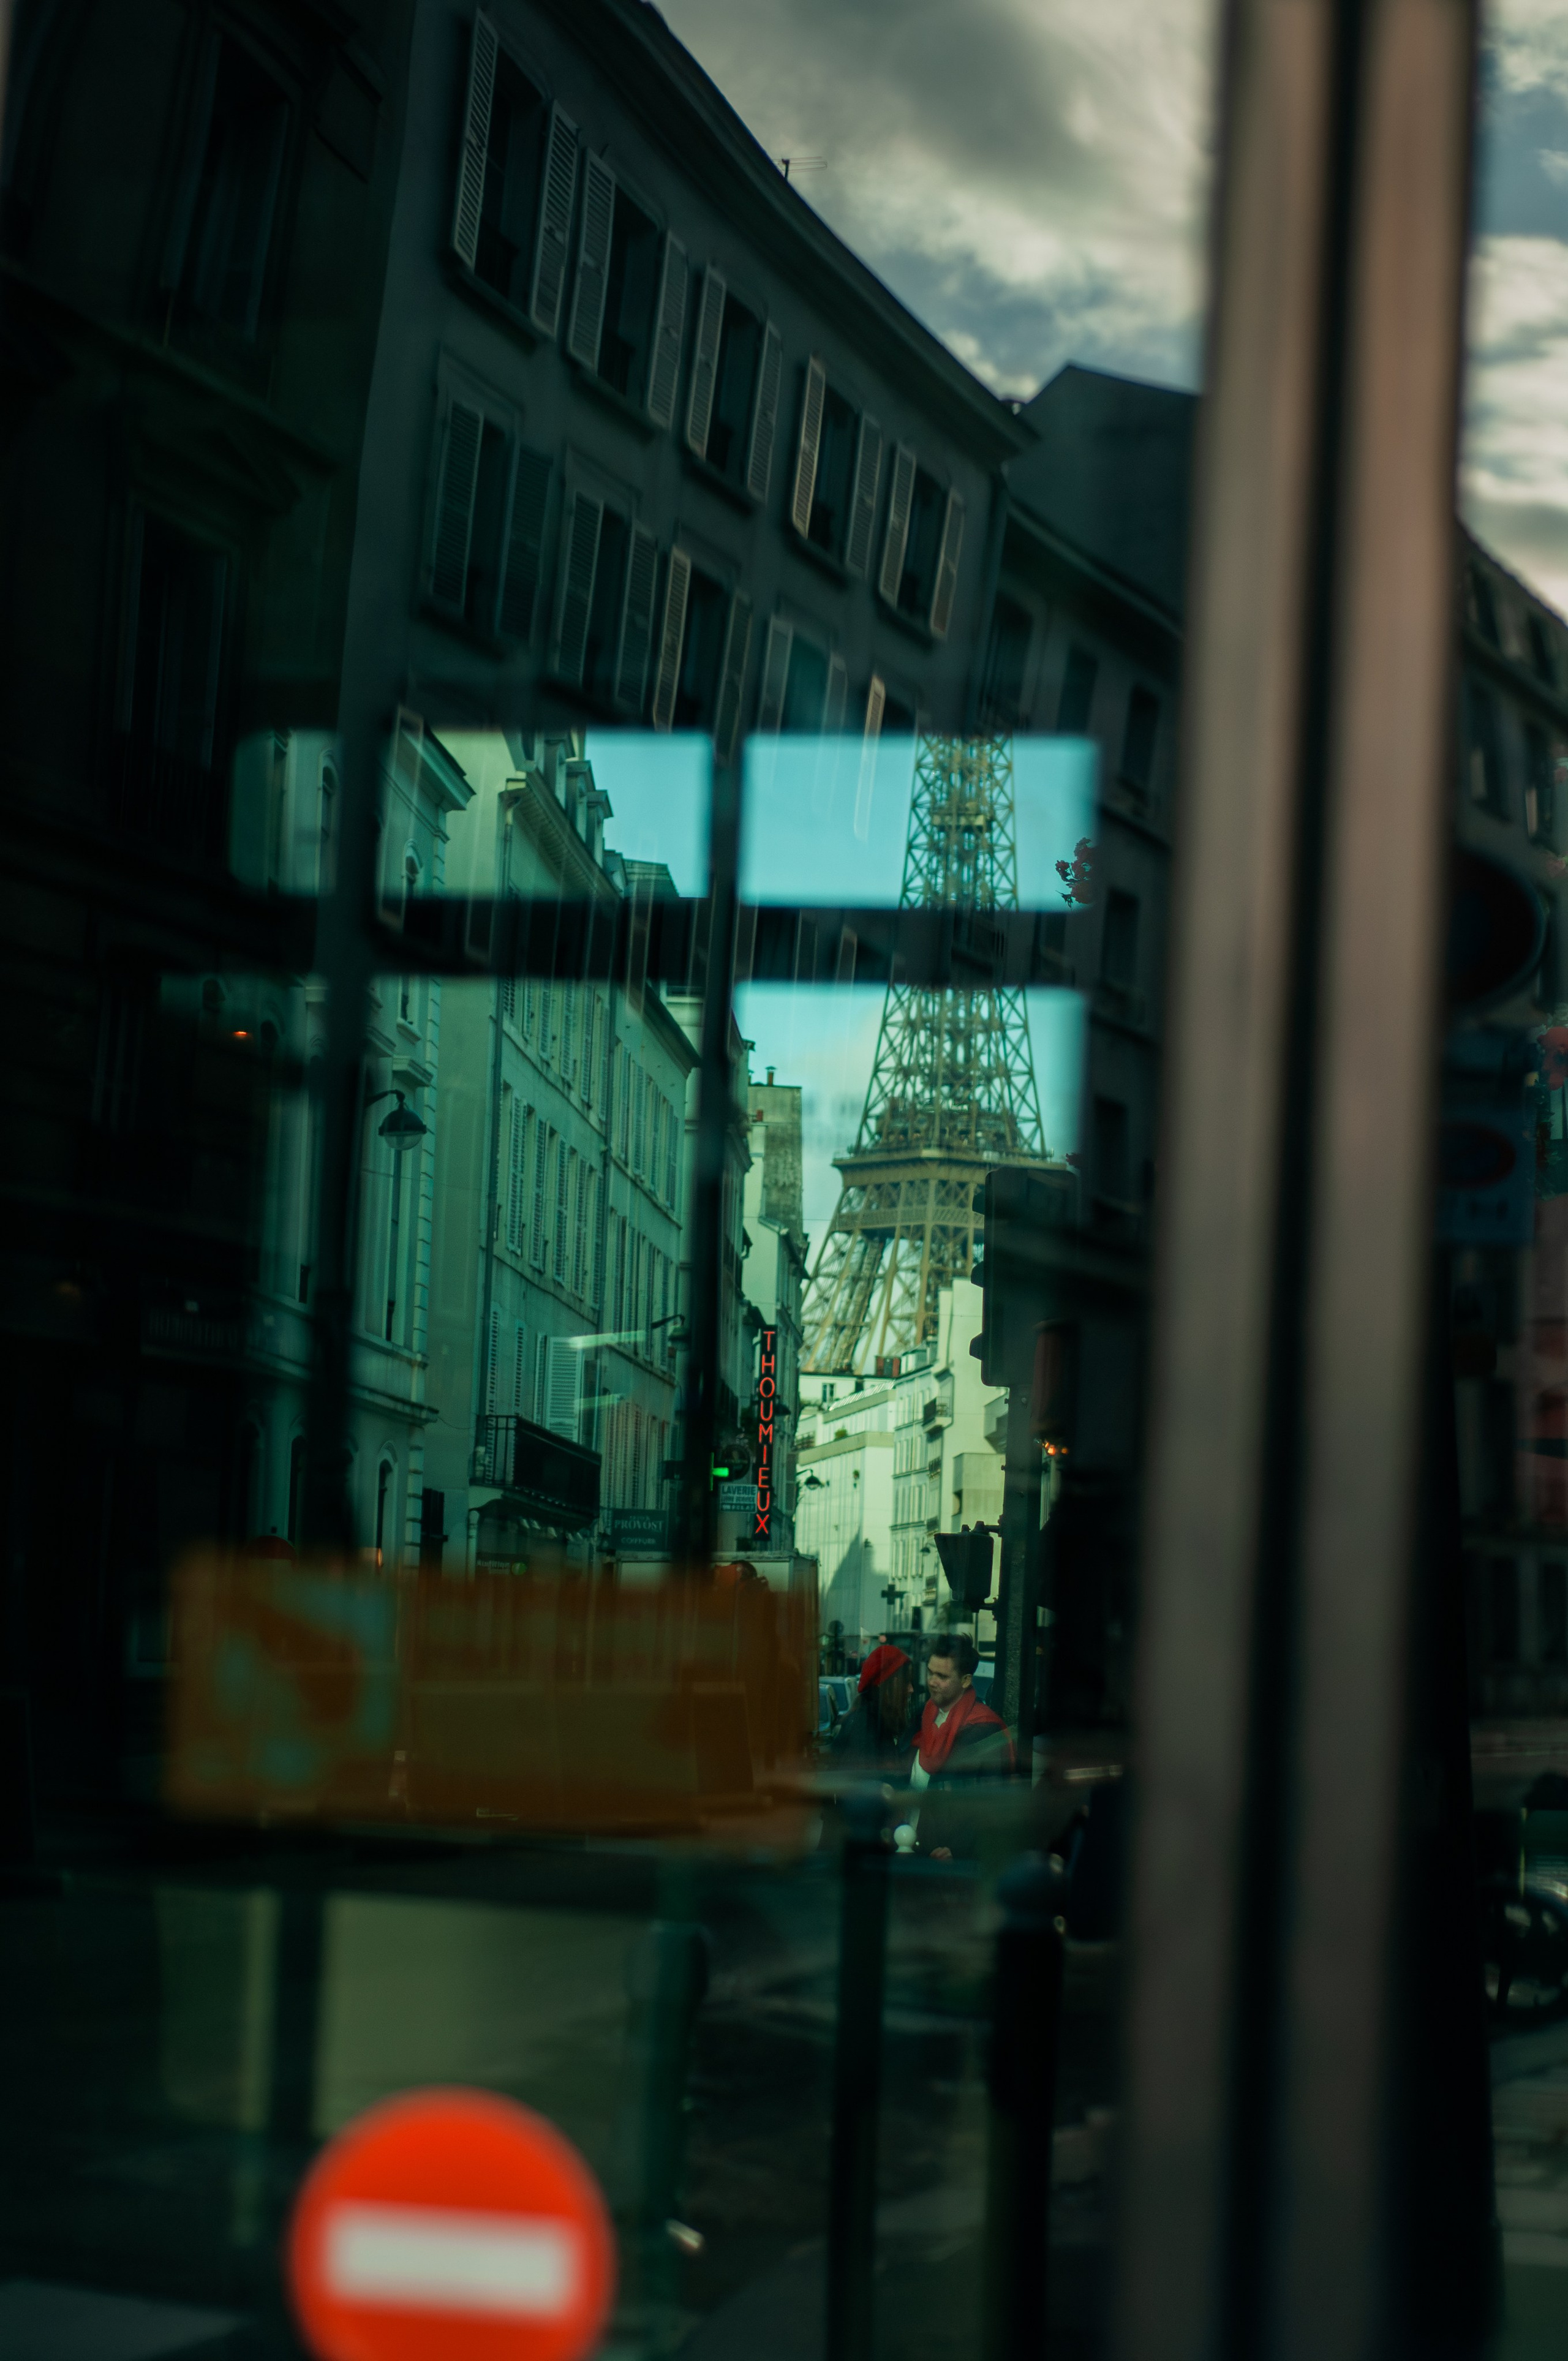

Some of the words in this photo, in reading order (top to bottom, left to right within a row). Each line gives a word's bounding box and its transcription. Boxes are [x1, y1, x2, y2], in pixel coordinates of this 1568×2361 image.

[755, 1331, 775, 1534] THOUMIEUX
[722, 1486, 756, 1495] LAVERIE
[614, 1519, 664, 1532] PROVOST
